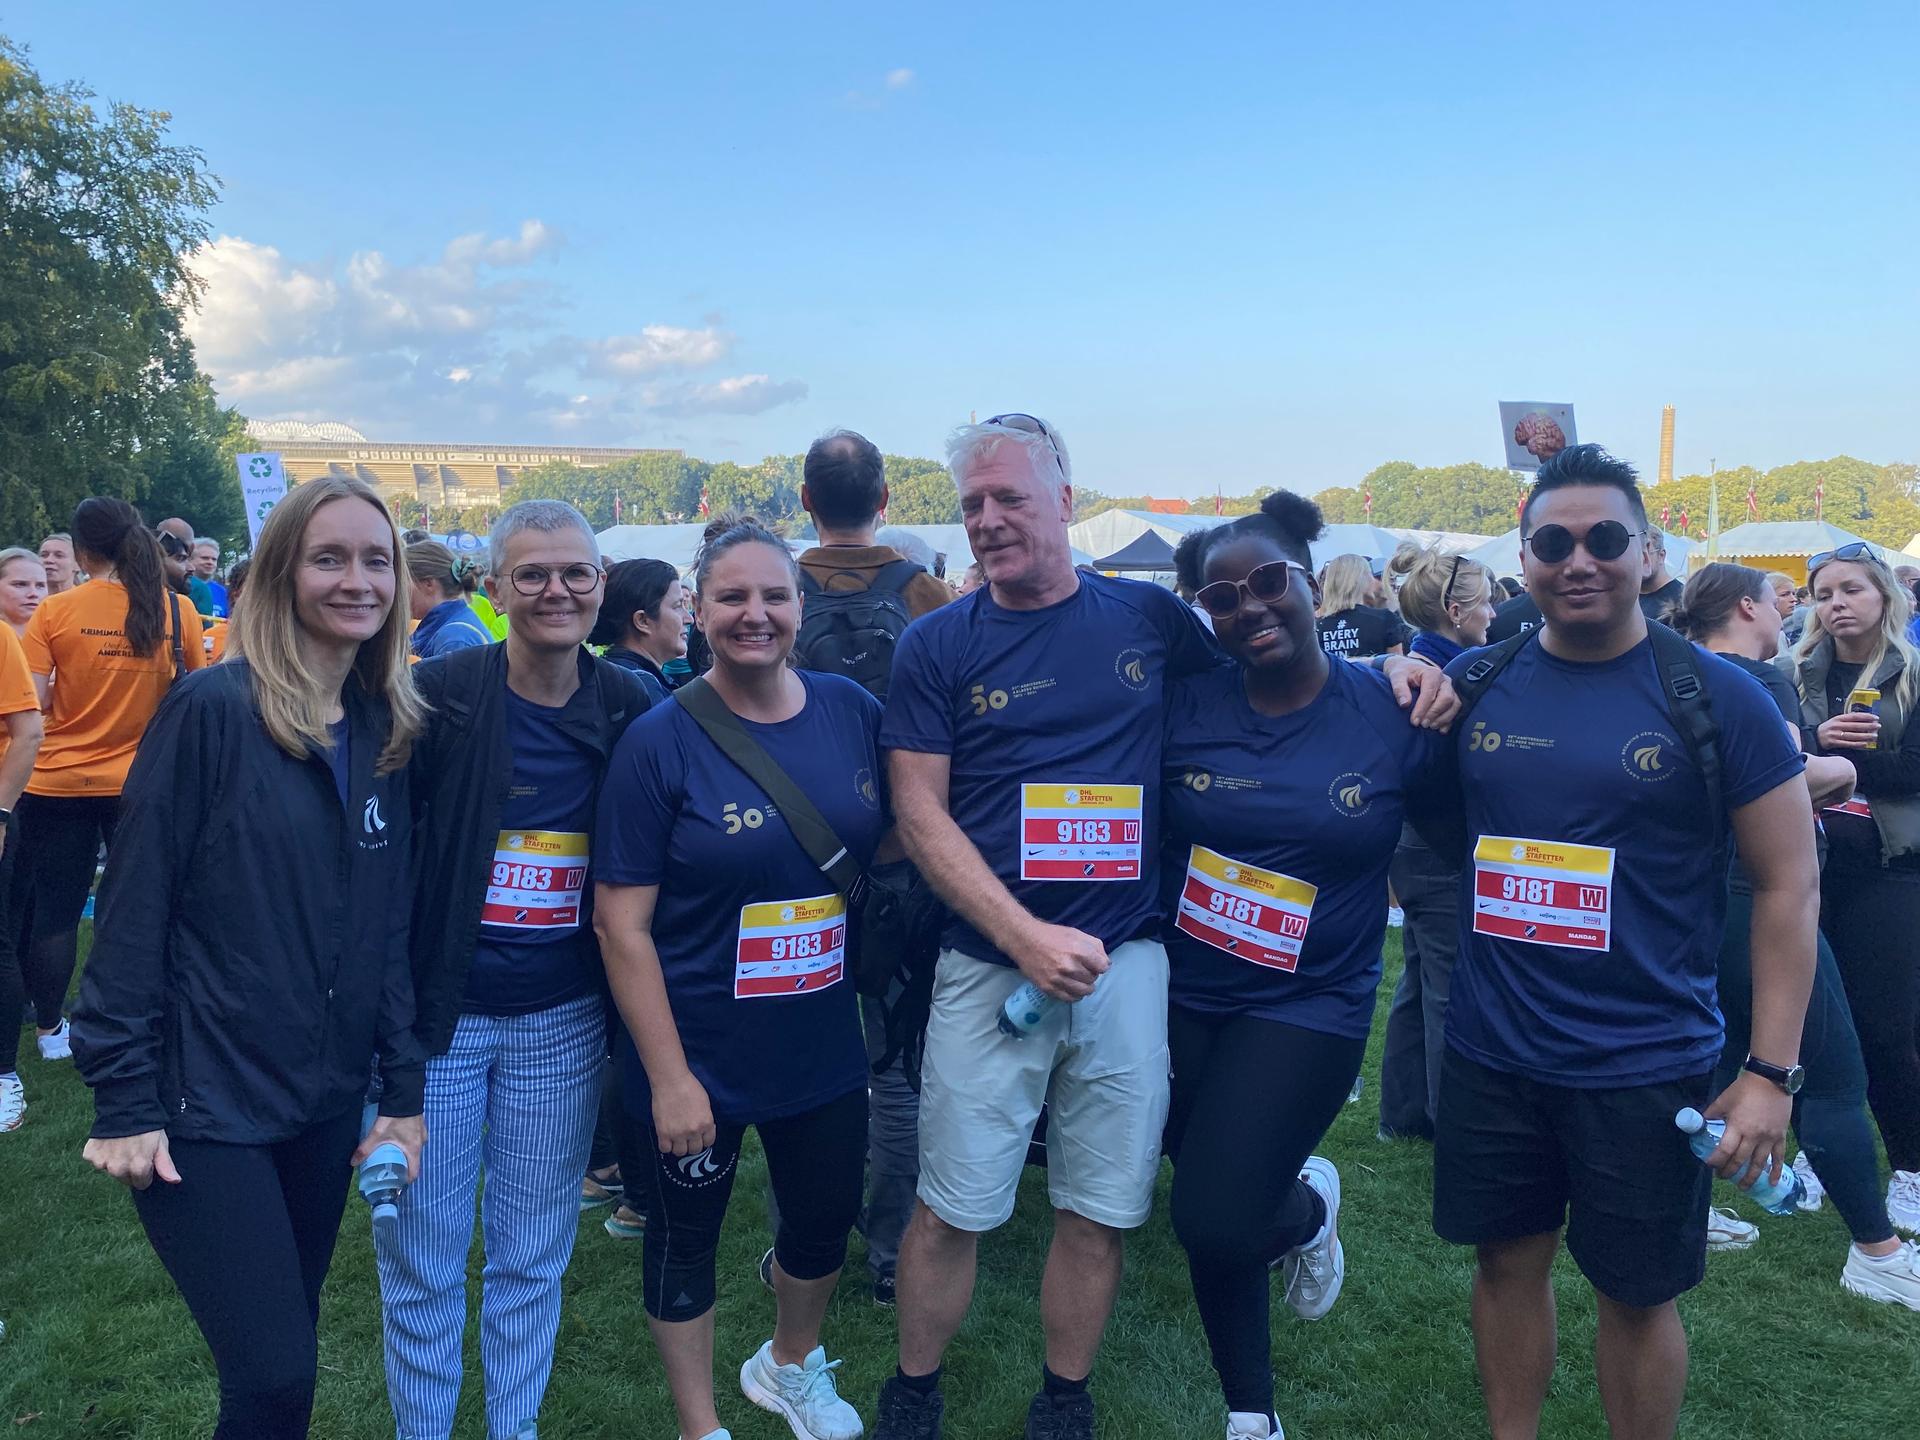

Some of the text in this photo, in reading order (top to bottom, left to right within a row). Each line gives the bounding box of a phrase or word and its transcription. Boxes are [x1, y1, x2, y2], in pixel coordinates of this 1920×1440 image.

[247, 486, 283, 495] Recycling
[1337, 619, 1347, 629] #
[1323, 628, 1359, 641] EVERY
[1324, 639, 1359, 651] BRAIN
[971, 684, 1009, 716] 50
[1469, 722, 1501, 753] 50
[722, 802, 764, 835] 50
[1057, 820, 1137, 843] 9183 W
[523, 840, 561, 849] STAFETTEN
[1526, 845, 1540, 853] DHL
[1525, 852, 1564, 862] STAFETTEN
[492, 863, 581, 890] 9183 W
[1240, 869, 1254, 877] DHL
[1239, 875, 1275, 890] STAFETTEN
[1502, 876, 1602, 908] 9181 W
[1209, 891, 1262, 927] 9181
[1283, 918, 1302, 936] W
[1568, 933, 1597, 941] MANDAG
[771, 933, 822, 960] 9183
[1263, 952, 1288, 963] MANDAG
